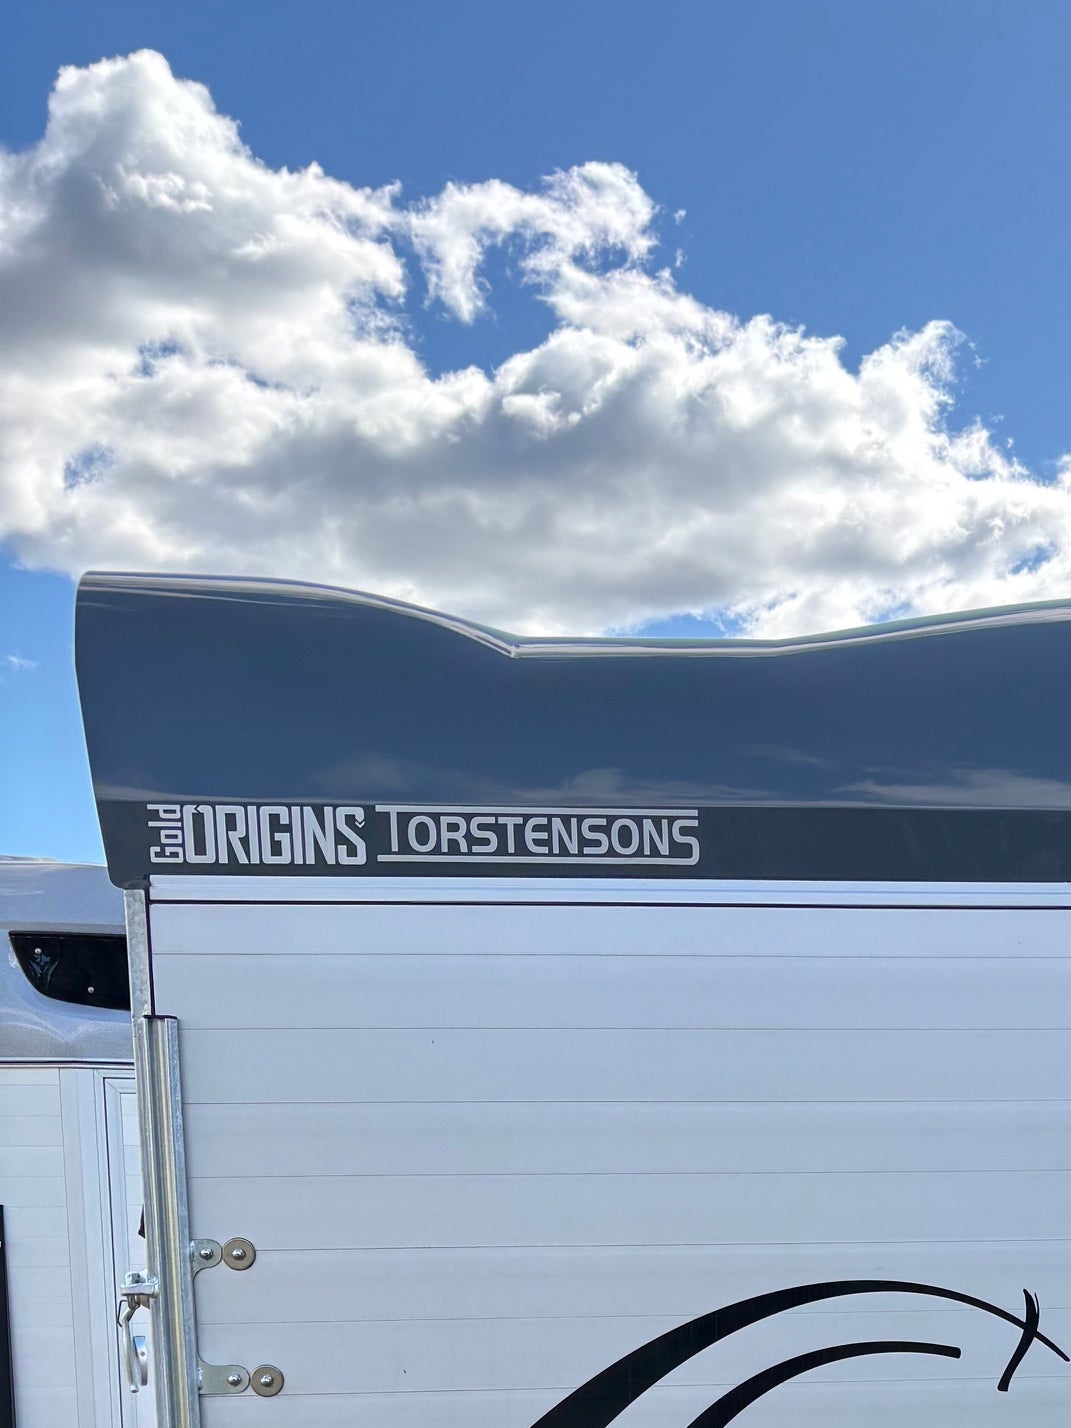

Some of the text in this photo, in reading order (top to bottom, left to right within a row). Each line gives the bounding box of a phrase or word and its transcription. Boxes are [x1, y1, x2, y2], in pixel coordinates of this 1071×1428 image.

[147, 804, 184, 863] Gold
[183, 804, 367, 866] ORIGINS
[375, 804, 700, 866] TORSTENSONS
